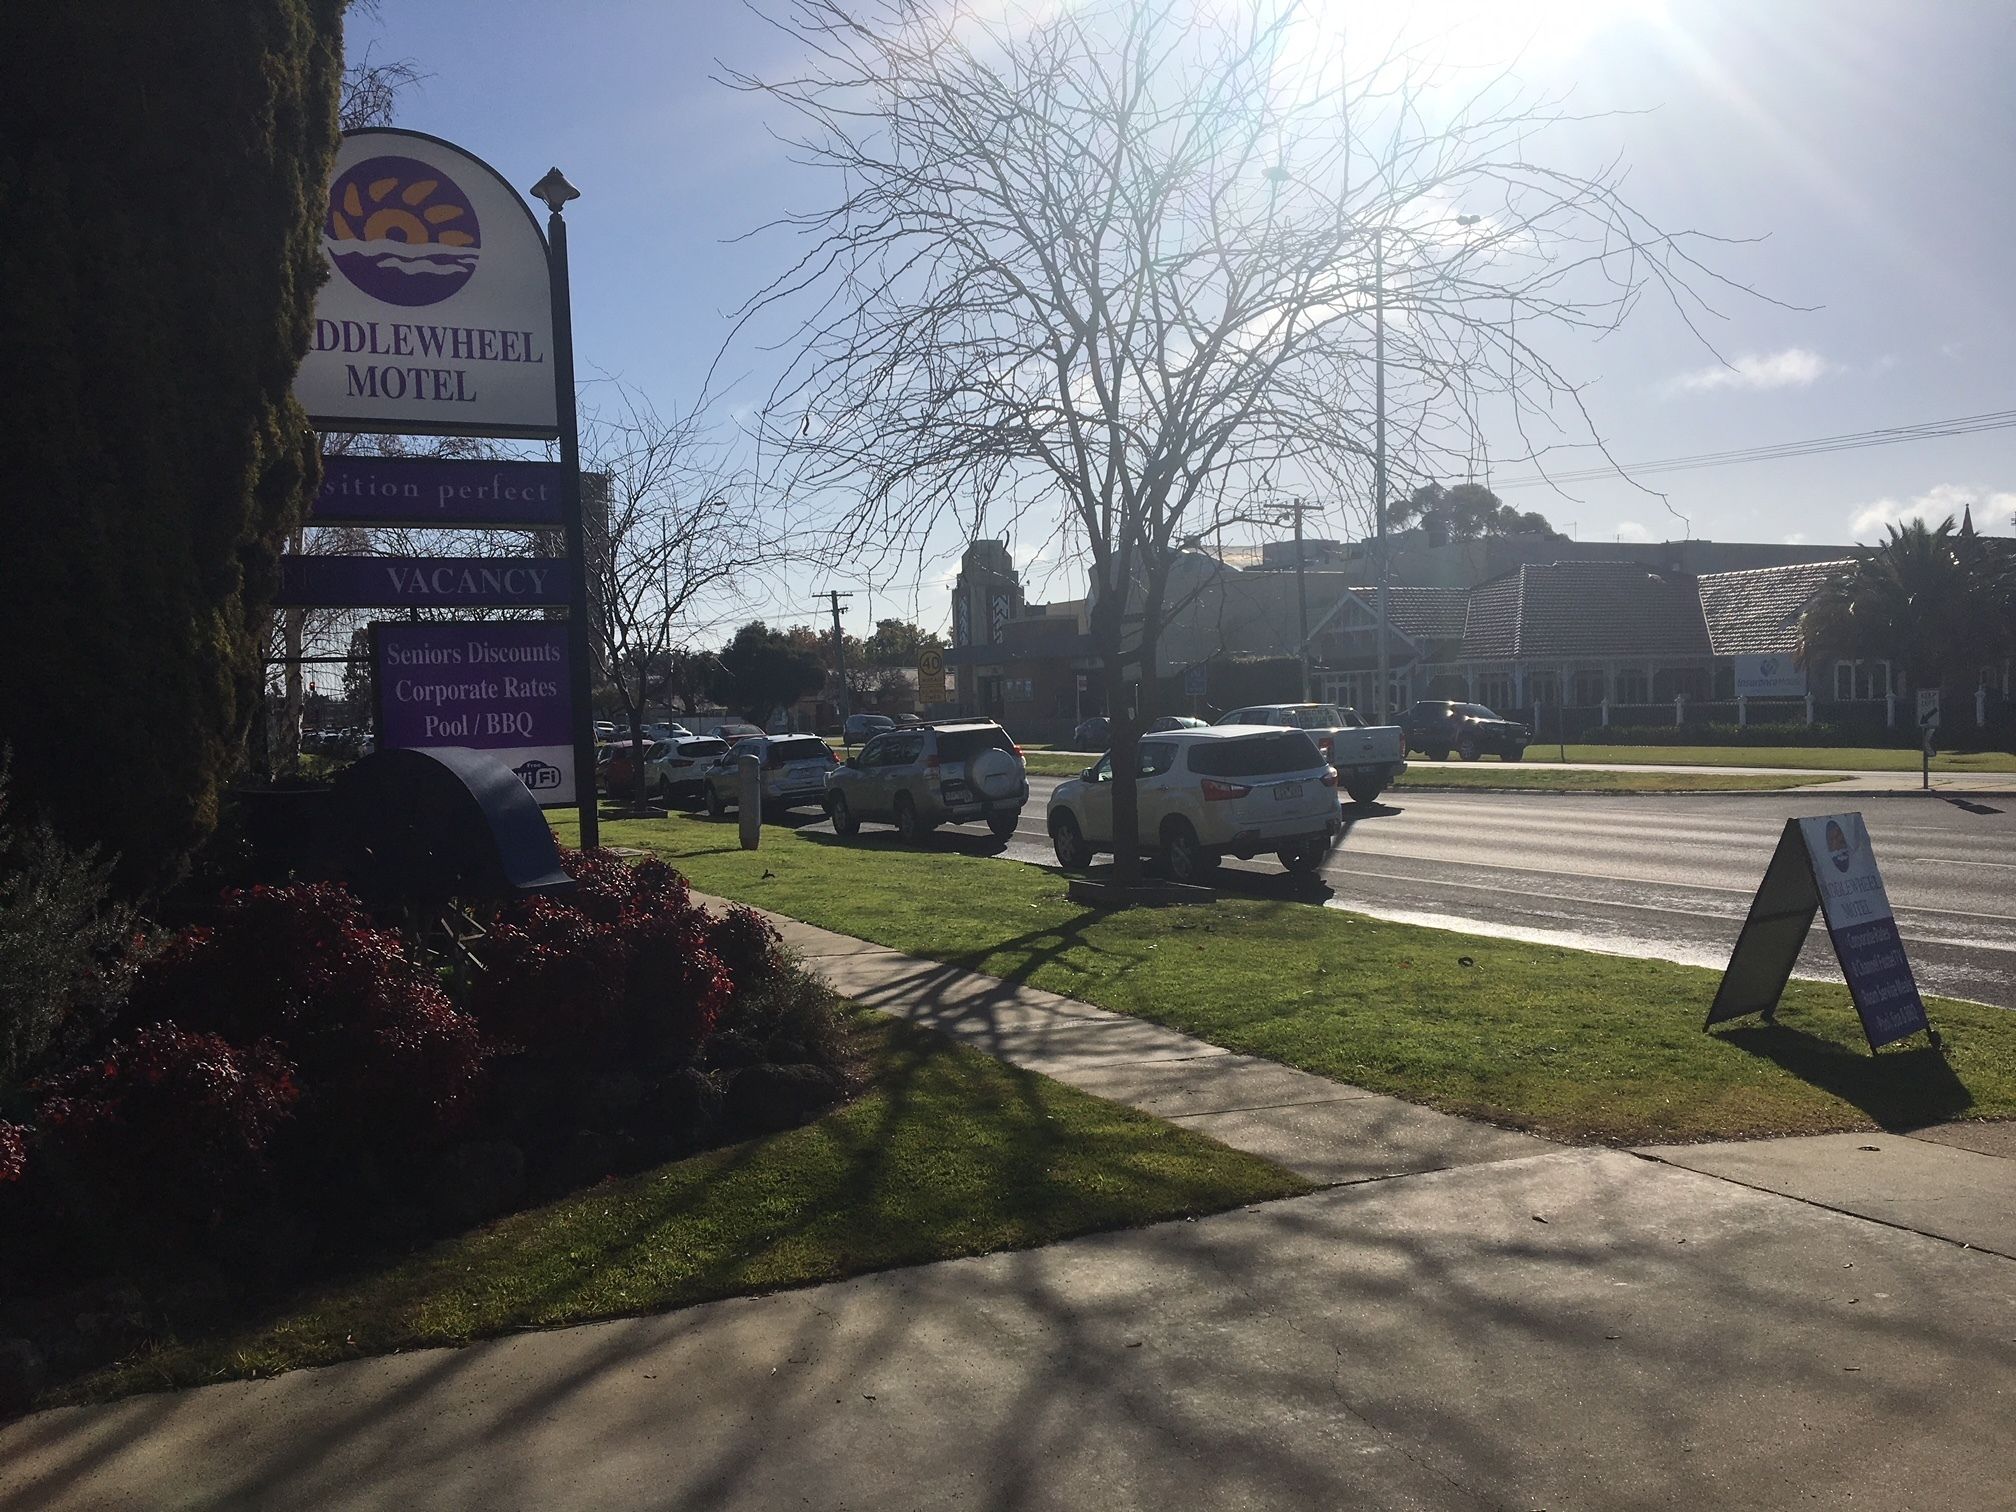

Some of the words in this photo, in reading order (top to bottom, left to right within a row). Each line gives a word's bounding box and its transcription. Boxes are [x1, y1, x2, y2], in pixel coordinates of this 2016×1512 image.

[310, 319, 543, 363] DDLEWHEEL
[345, 364, 477, 401] MOTEL
[325, 474, 420, 497] sition
[438, 473, 549, 507] perfect
[386, 567, 549, 595] VACANCY
[387, 642, 462, 665] Seniors
[468, 641, 561, 664] Discounts
[922, 656, 939, 669] 40
[395, 678, 498, 706] Corporate
[503, 676, 557, 699] Rates
[424, 715, 469, 738] Pool
[487, 711, 534, 738] BBQ
